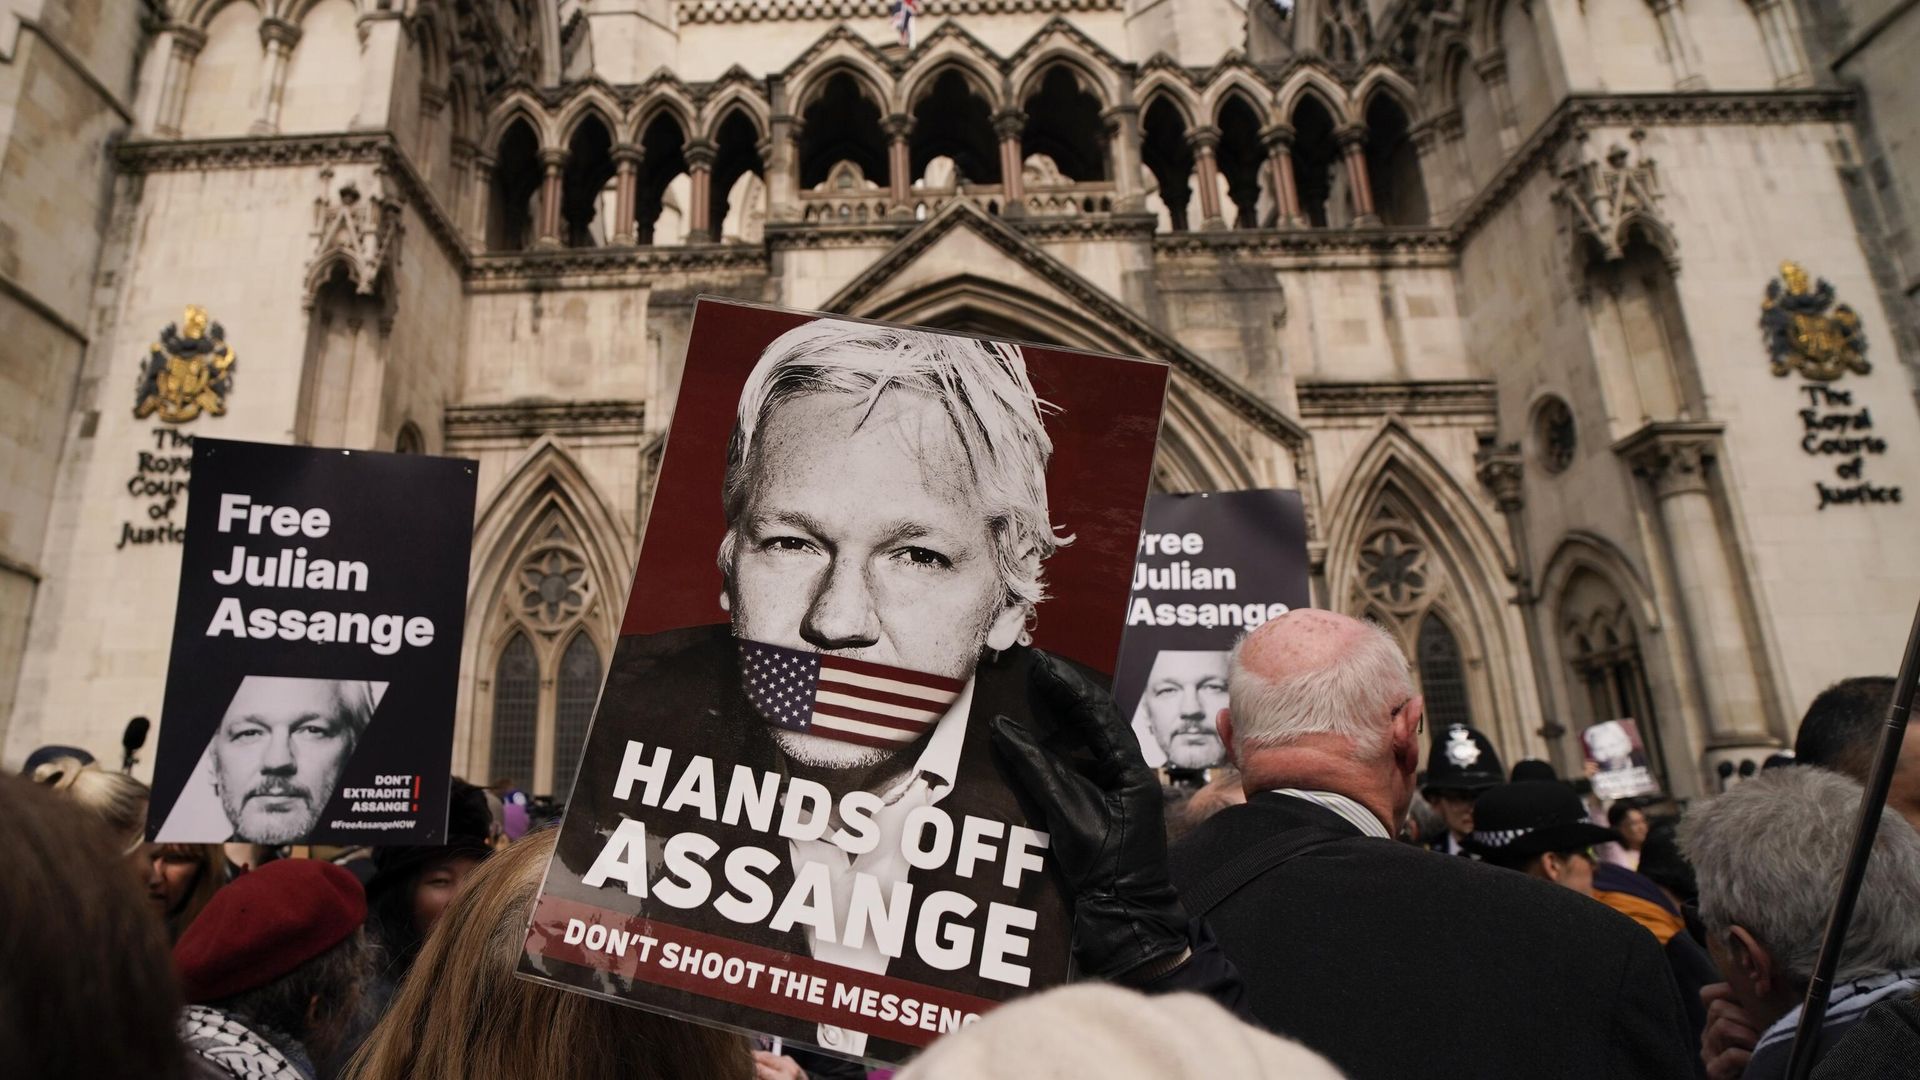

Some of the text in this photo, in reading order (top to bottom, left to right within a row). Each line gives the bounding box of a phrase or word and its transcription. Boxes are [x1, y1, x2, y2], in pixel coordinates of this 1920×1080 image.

[1800, 384, 1852, 406] The
[1799, 408, 1872, 433] Royal
[138, 451, 192, 474] Roya
[128, 476, 189, 497] Cour
[148, 497, 176, 519] of
[217, 493, 331, 538] Free
[116, 522, 186, 549] Justic
[212, 546, 369, 592] Julian
[1131, 560, 1237, 590] Julian
[205, 597, 435, 655] Assange
[375, 775, 412, 785] DON'T
[343, 788, 411, 799] EXTRADITE
[351, 802, 409, 812] ASSANGE
[613, 739, 1050, 889] HANDS OFF
[330, 820, 416, 831] #FreeAssangeNOW
[582, 817, 1038, 988] ASSANGE
[659, 942, 765, 989] SHOOT
[768, 966, 827, 1005] THE
[831, 982, 982, 1035] MESSEN
